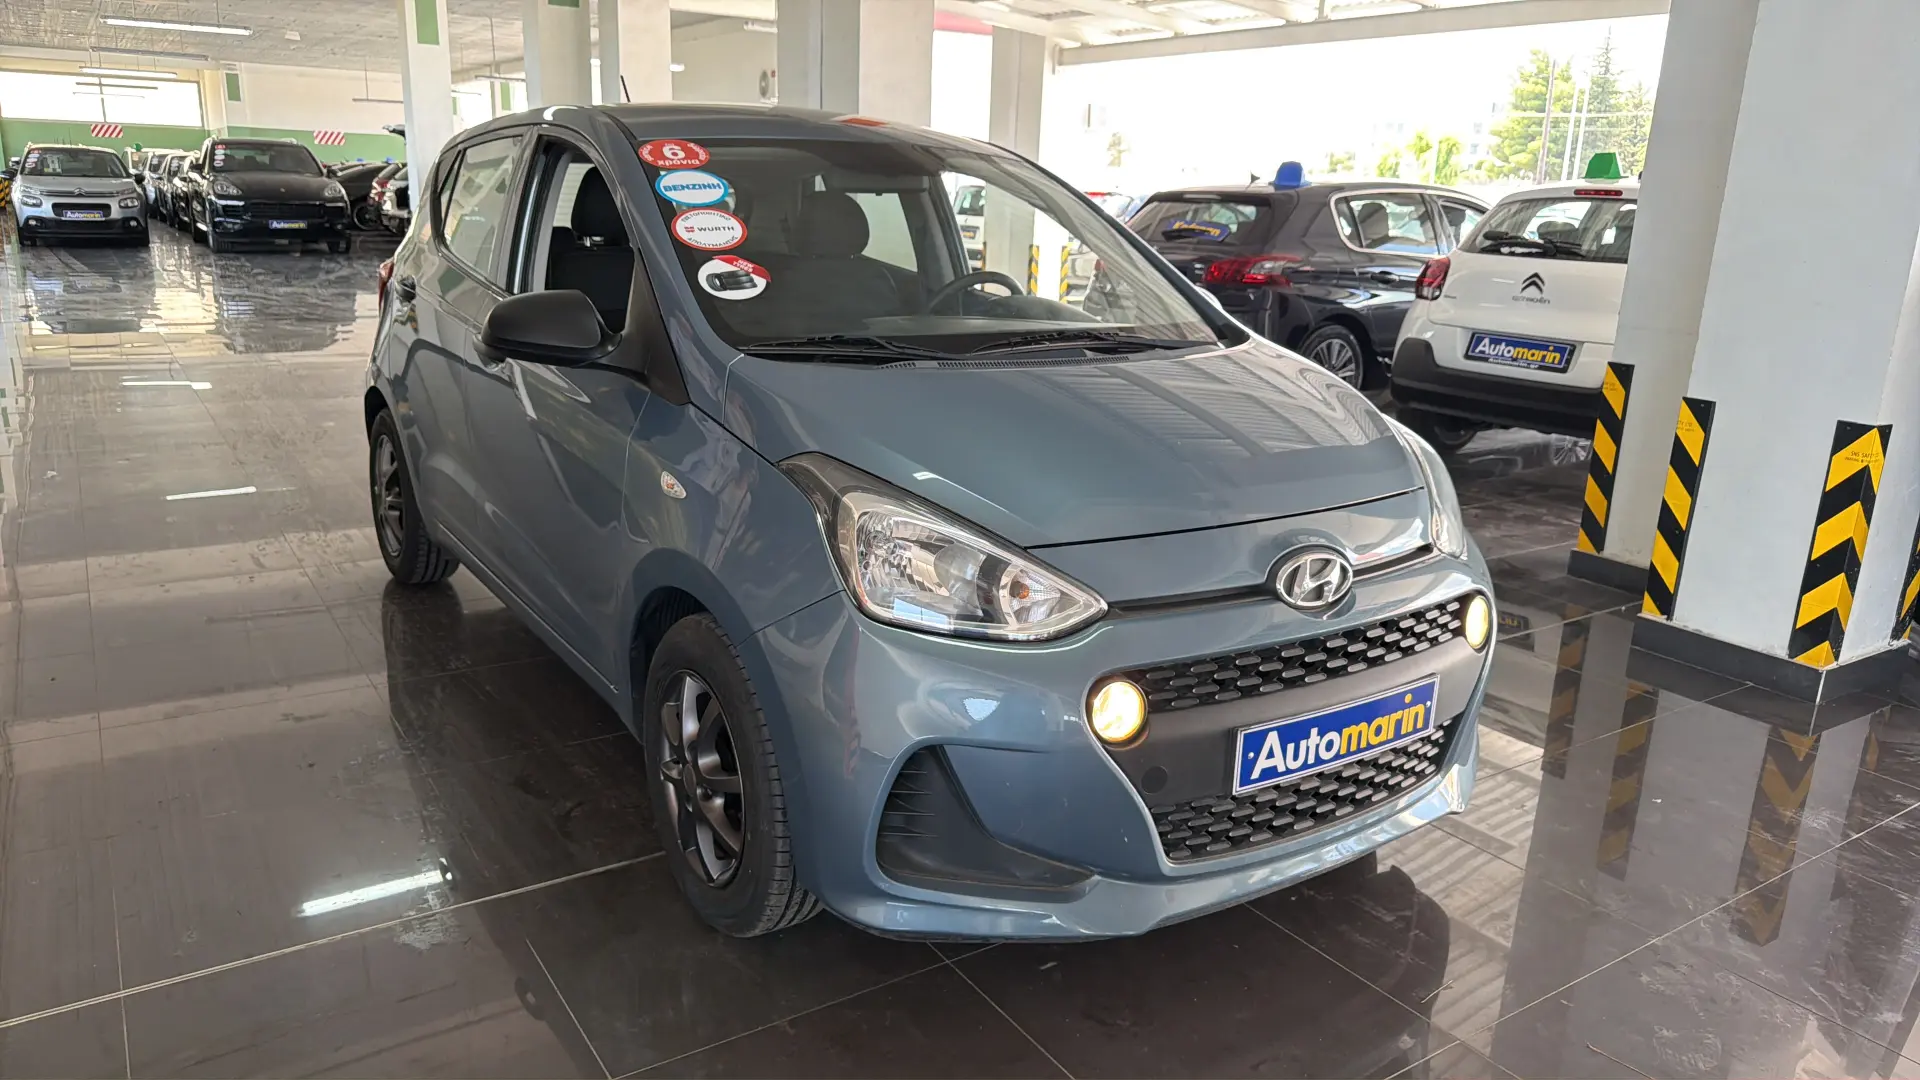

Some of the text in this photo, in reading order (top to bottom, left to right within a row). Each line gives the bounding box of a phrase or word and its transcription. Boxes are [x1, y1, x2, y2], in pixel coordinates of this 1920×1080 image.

[662, 145, 686, 160] 6
[1474, 337, 1561, 364] Automarin
[1249, 693, 1425, 780] Automarin
